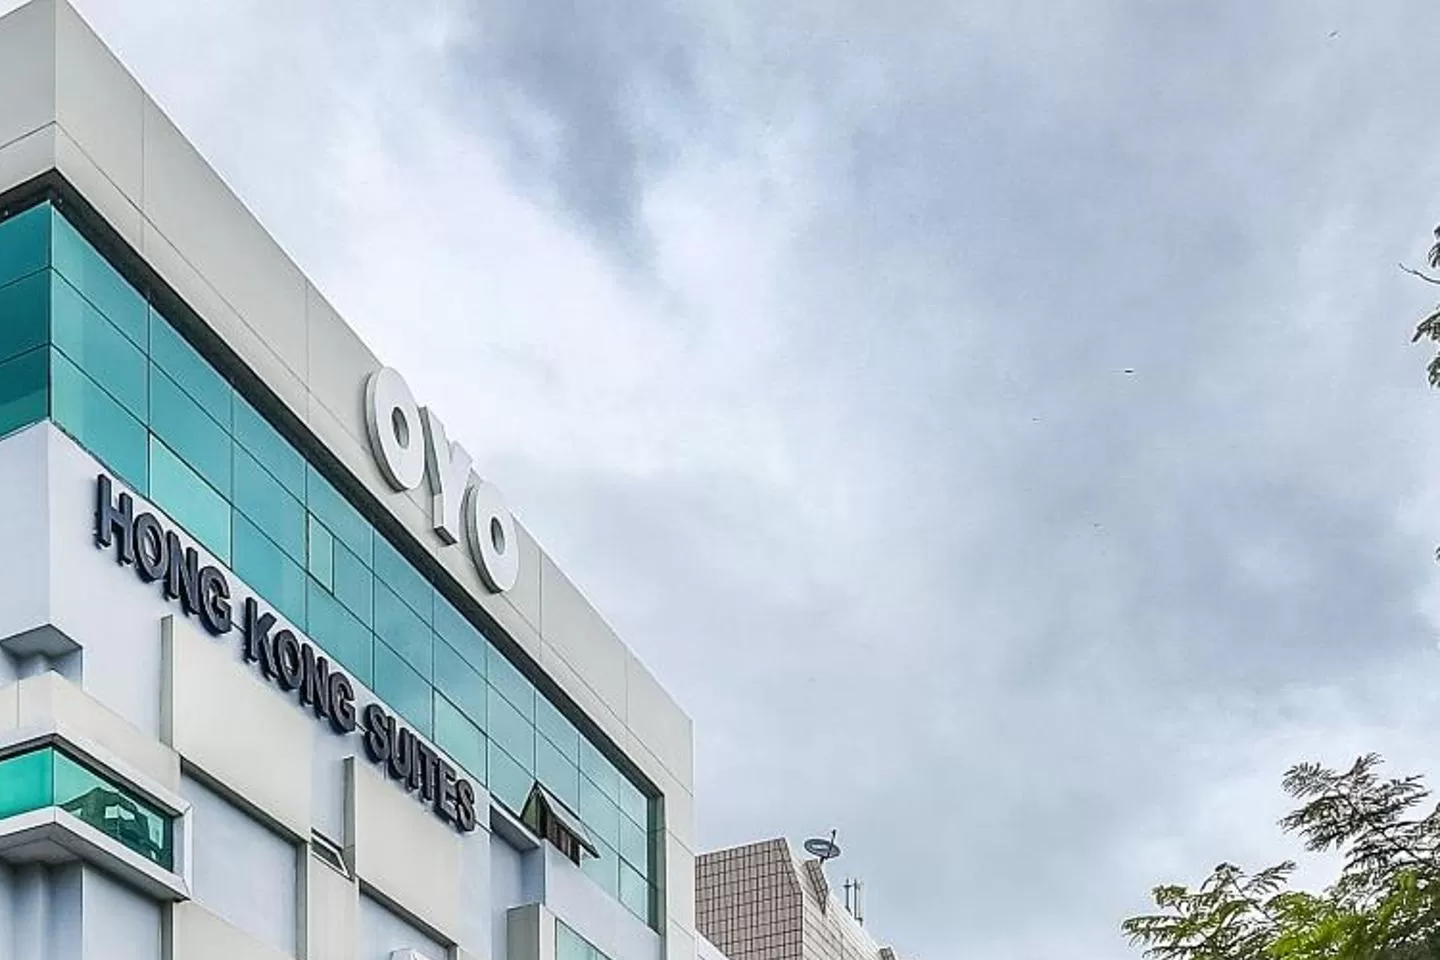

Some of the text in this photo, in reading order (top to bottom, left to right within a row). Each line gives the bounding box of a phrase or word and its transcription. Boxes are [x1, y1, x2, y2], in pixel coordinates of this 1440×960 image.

[363, 366, 520, 595] OYO
[95, 472, 477, 834] HONG KONG SUITES
